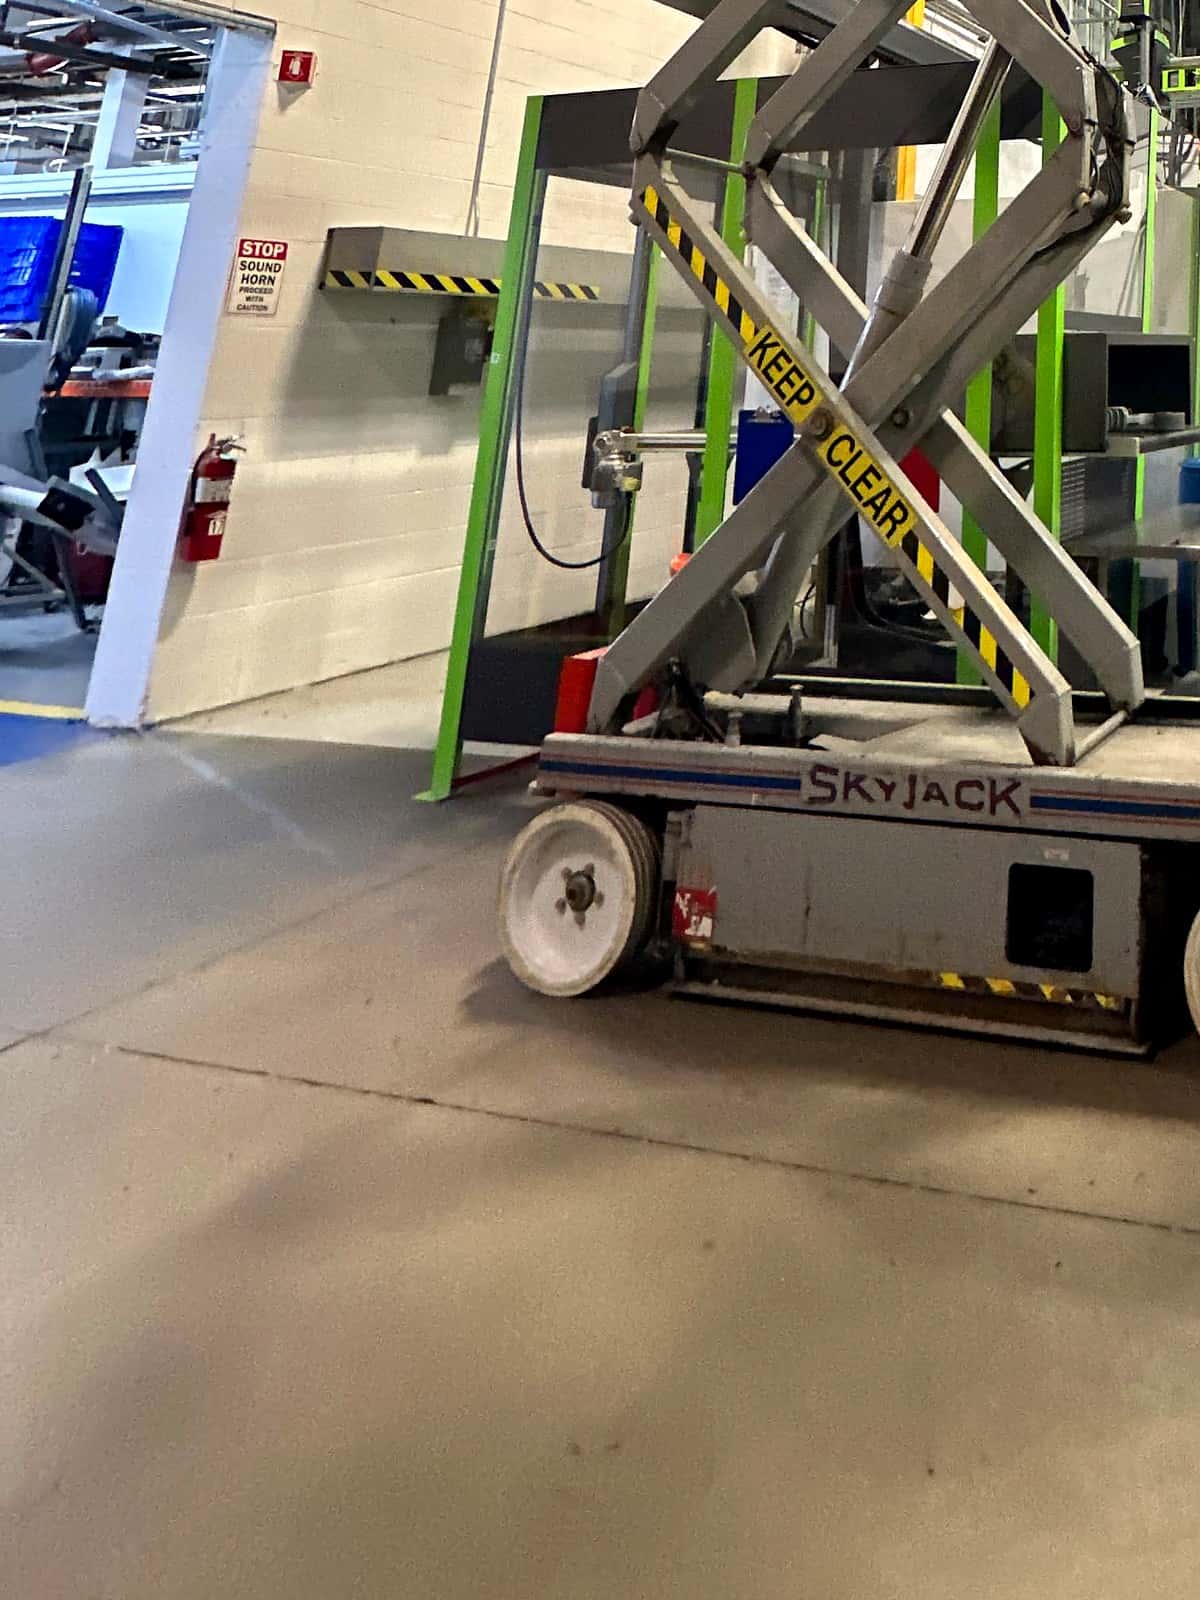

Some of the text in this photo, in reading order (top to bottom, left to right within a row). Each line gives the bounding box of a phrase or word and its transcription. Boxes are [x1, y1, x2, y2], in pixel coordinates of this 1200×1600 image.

[242, 241, 285, 257] STOP
[239, 260, 282, 273] SOUND
[240, 273, 276, 286] HORN
[239, 286, 274, 294] PROCEED
[236, 303, 268, 312] CAUTION
[748, 331, 909, 542] KEEP CLEAR
[807, 764, 1022, 817] SKYJACK
